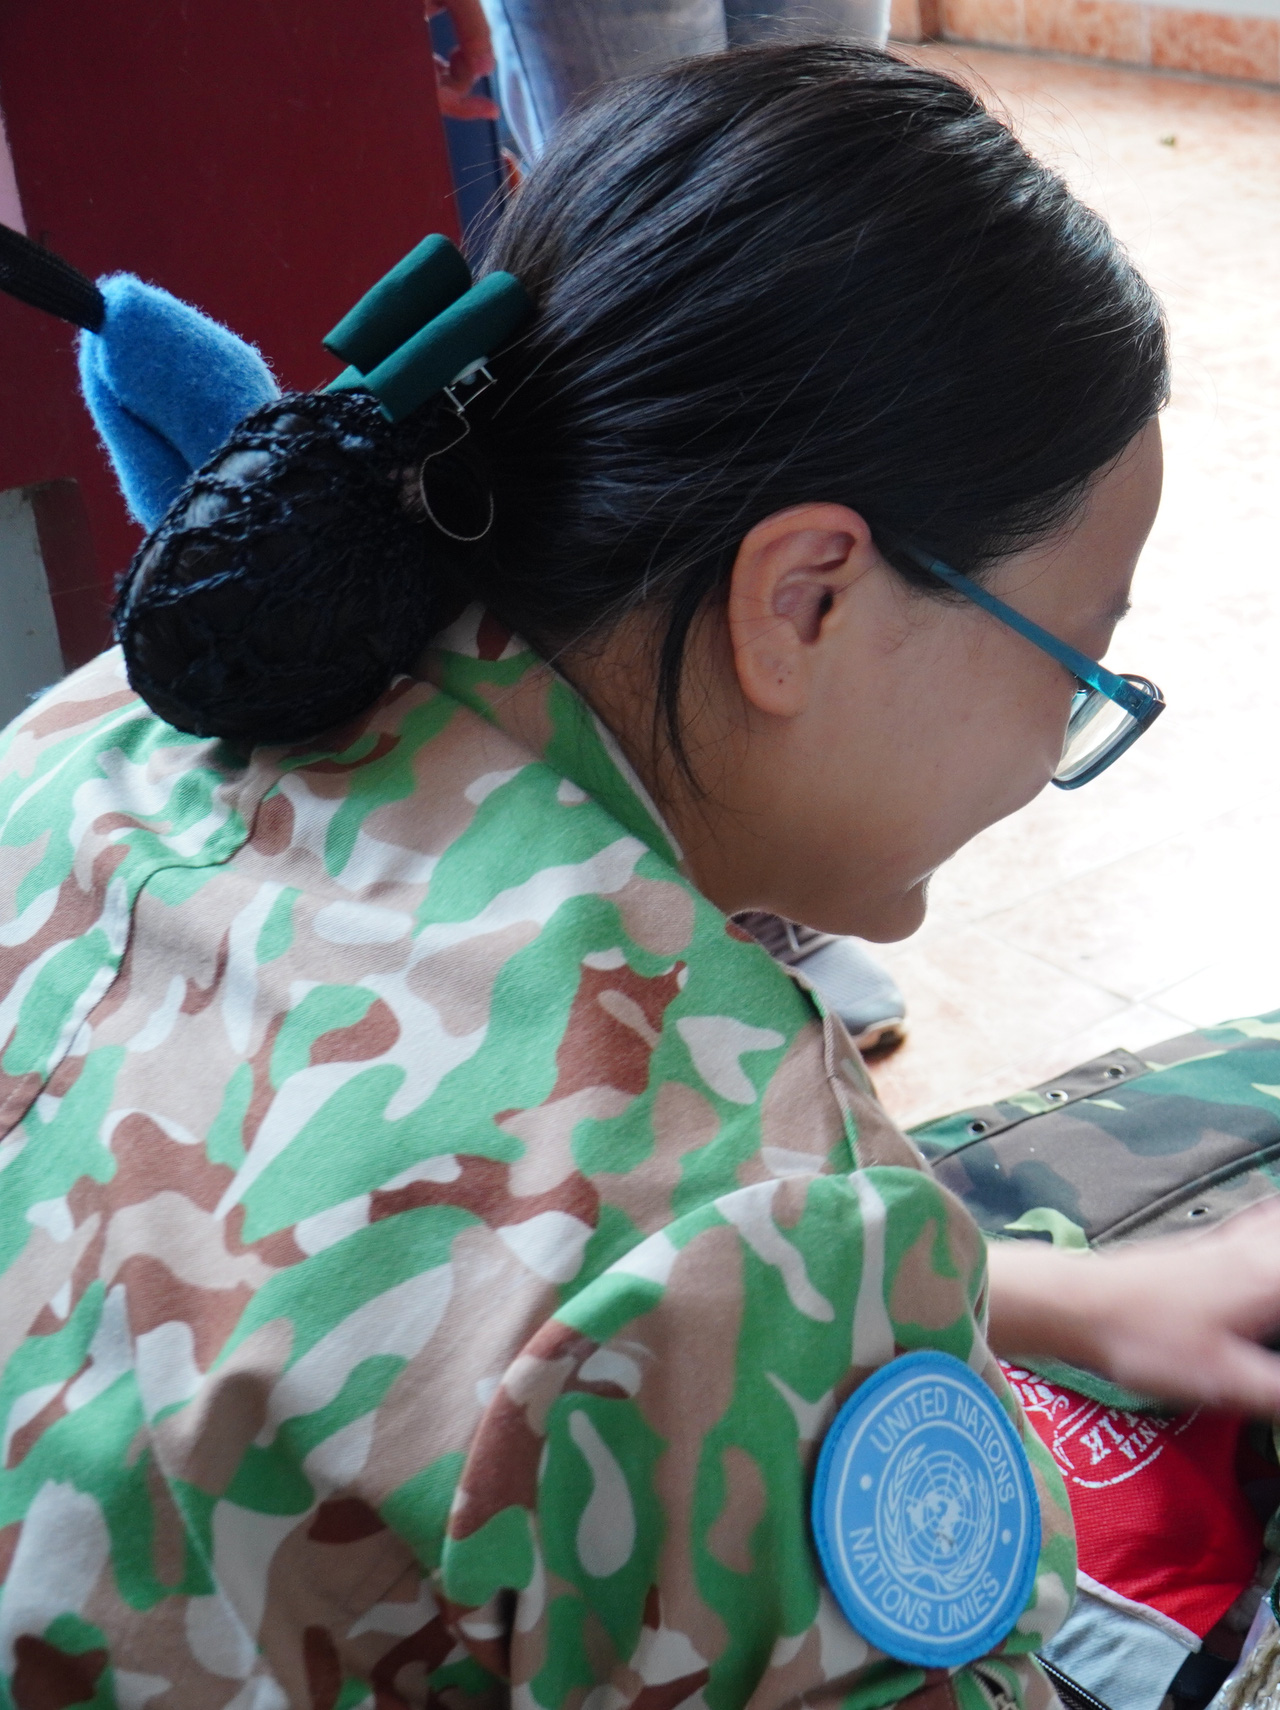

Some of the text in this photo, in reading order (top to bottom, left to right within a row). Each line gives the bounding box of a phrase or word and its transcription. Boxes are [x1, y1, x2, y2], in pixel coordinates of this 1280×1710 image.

[870, 1386, 1015, 1503] UNITED NATIONS
[850, 1526, 999, 1633] NATIONS UNIES
